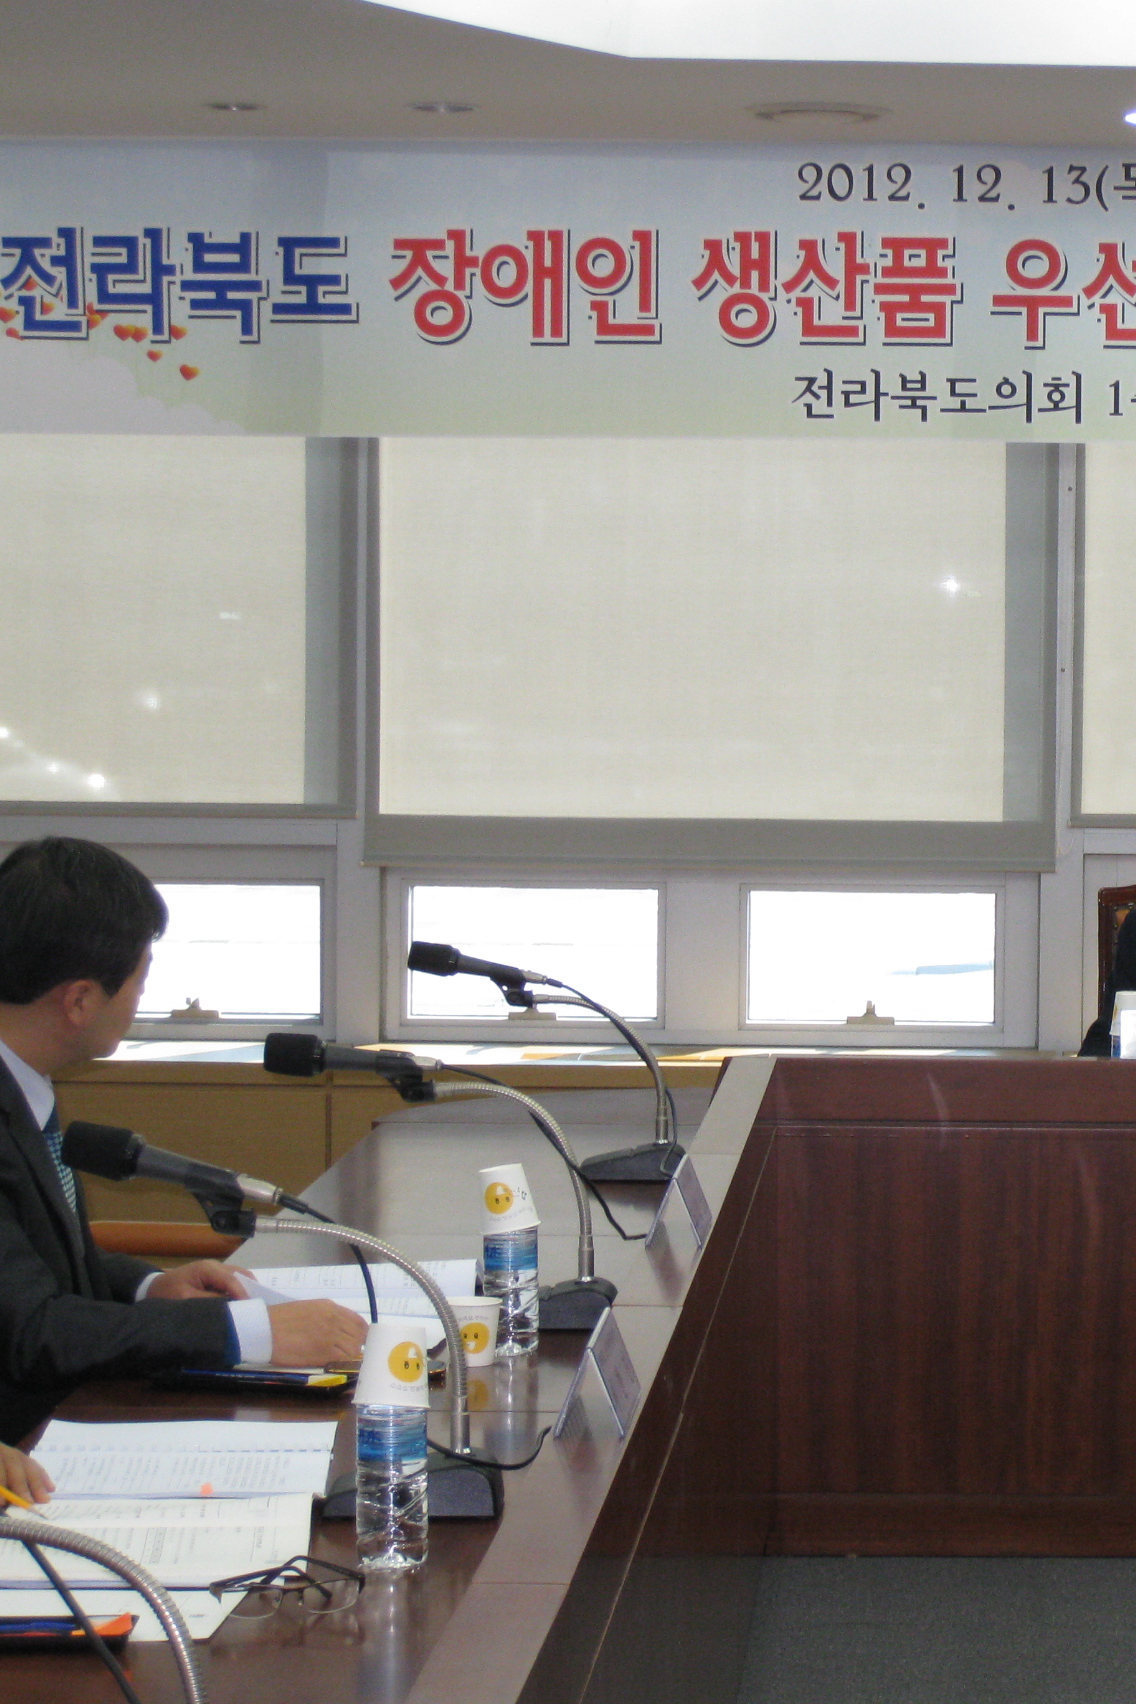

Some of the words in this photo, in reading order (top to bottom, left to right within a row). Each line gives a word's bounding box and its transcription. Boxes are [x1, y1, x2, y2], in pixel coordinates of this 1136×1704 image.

[797, 163, 926, 209] 2012.
[952, 164, 1017, 211] 12.
[0, 226, 359, 344] 전라북도
[389, 228, 662, 345] 장애인
[691, 230, 964, 347] 생산품
[791, 368, 1083, 425] 전라북도의회
